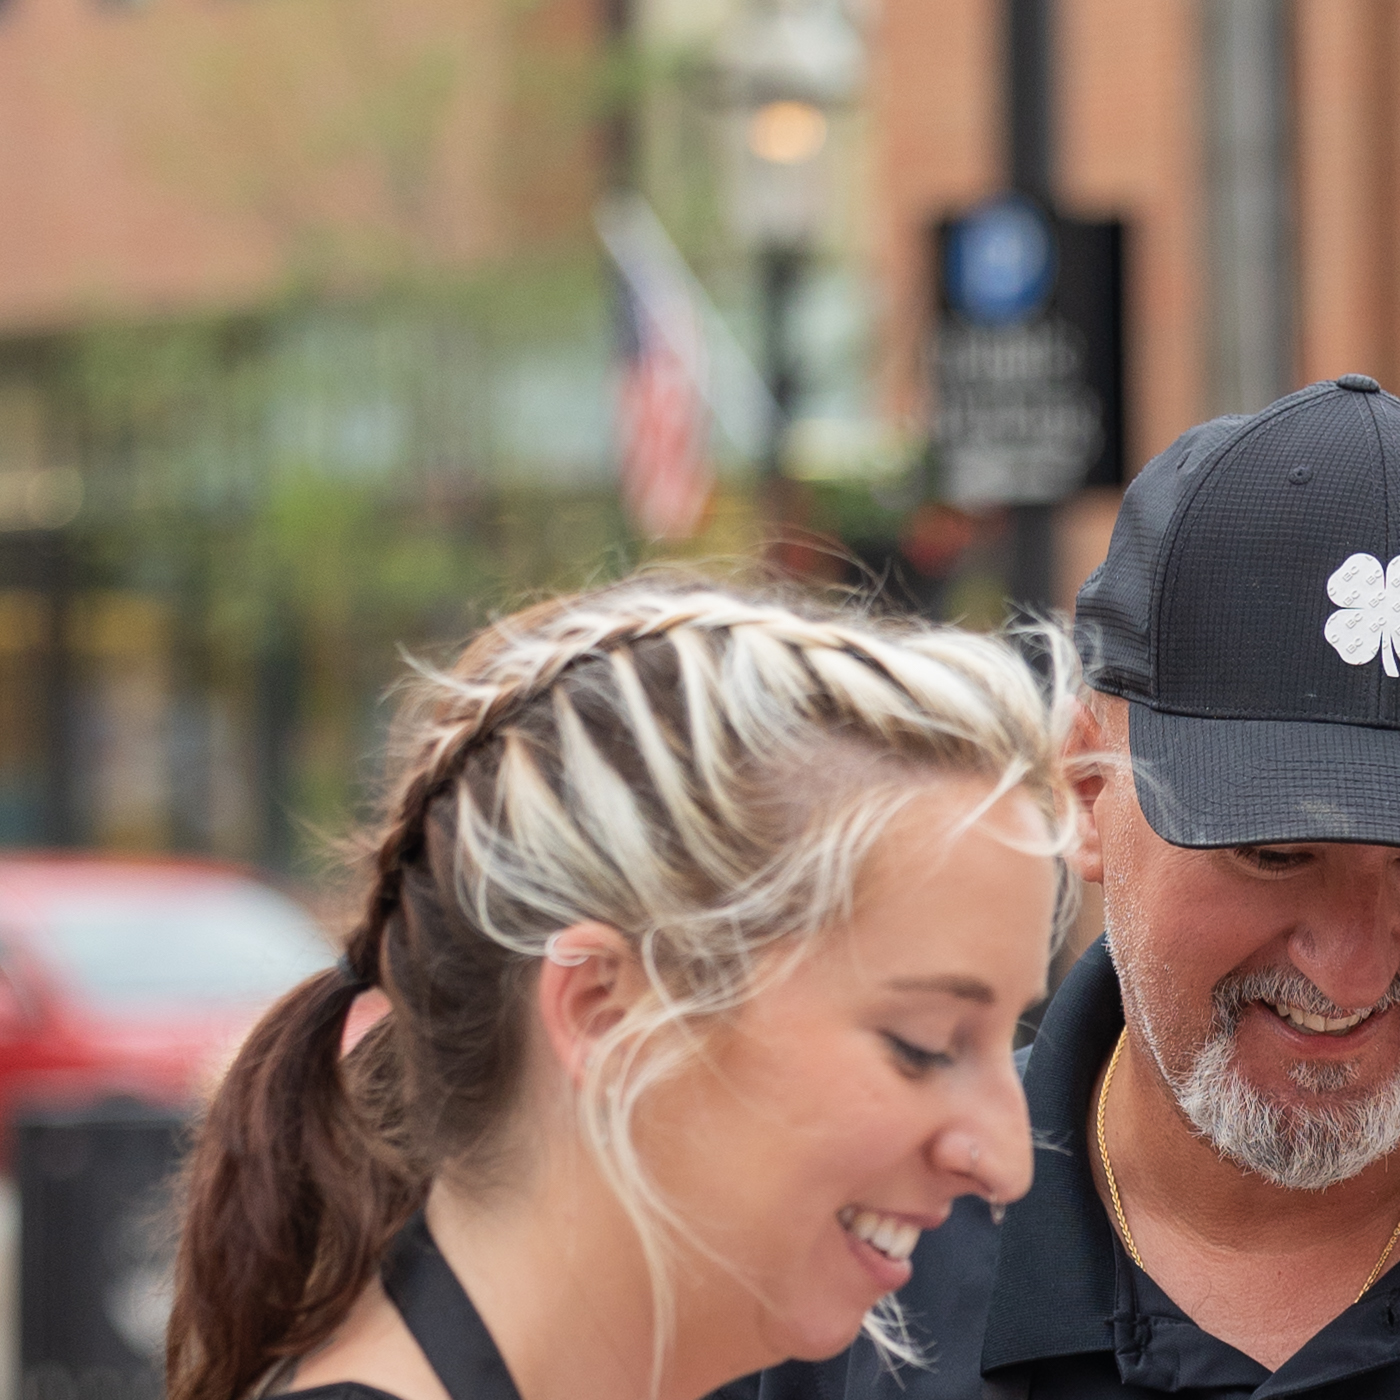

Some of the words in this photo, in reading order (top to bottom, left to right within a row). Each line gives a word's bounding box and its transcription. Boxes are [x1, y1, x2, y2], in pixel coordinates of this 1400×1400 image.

[1342, 566, 1359, 582] BC
[1366, 569, 1382, 585] BC
[1343, 590, 1360, 606] BC
[1368, 592, 1386, 608] BC
[1345, 613, 1363, 629] BC
[1369, 617, 1387, 633] BC
[1346, 638, 1363, 654] BC
